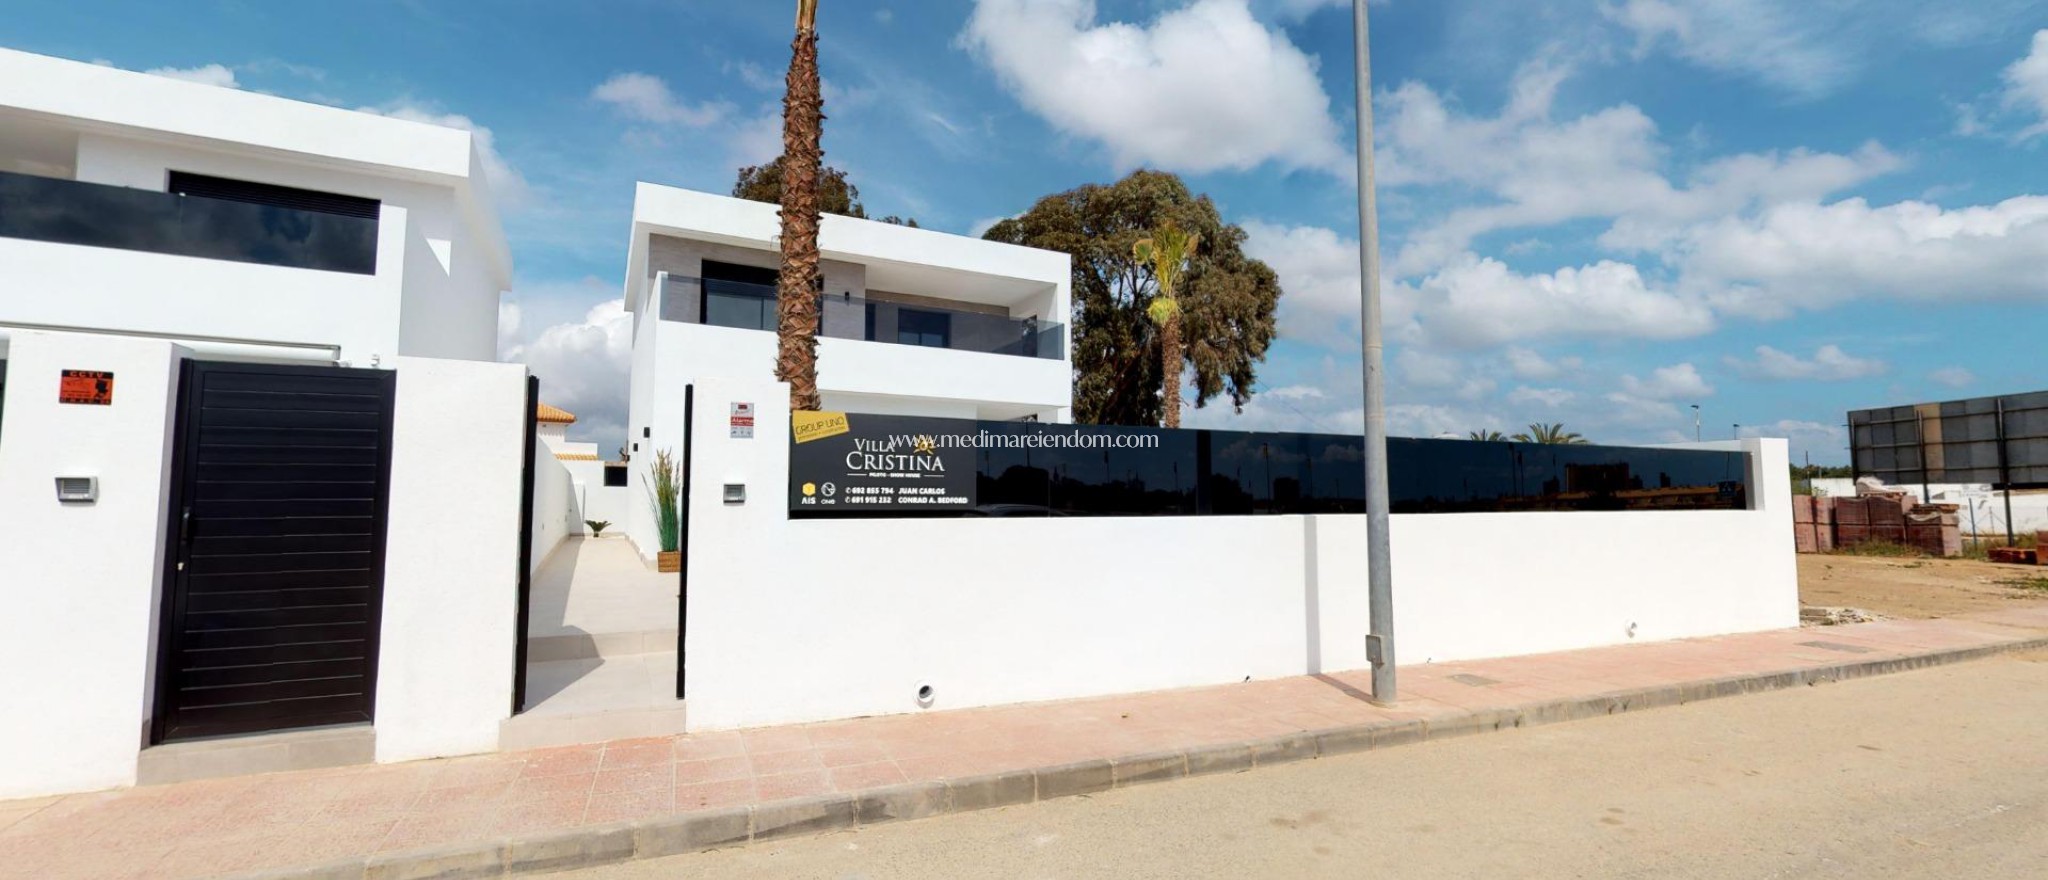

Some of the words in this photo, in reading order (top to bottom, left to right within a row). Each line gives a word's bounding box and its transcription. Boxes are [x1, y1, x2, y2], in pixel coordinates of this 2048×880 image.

[854, 438, 896, 453] VILLA
[846, 451, 945, 472] CRISTINA
[851, 487, 865, 495] 692
[898, 487, 918, 495] JUAN
[919, 487, 946, 496] CARLOS
[801, 497, 816, 505] AIS
[851, 496, 864, 504] 691
[898, 496, 928, 504] CONRAD
[937, 496, 968, 504] BEDFORD
